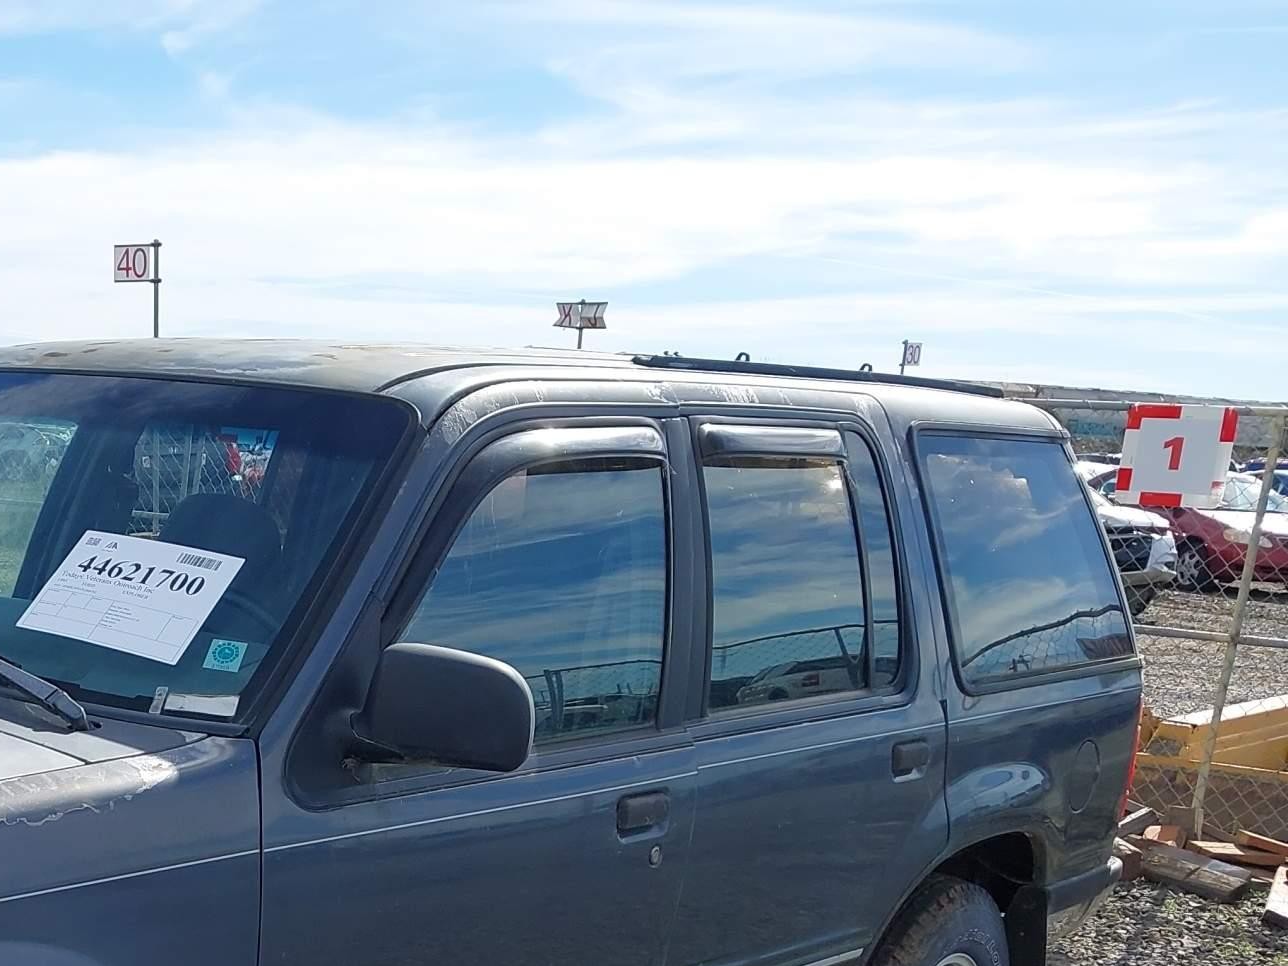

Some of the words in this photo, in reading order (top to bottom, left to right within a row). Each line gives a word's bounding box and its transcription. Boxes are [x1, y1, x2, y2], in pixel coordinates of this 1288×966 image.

[116, 248, 147, 278] 40
[906, 345, 920, 364] 30
[1164, 437, 1184, 470] 1
[77, 555, 205, 596] 44621700
